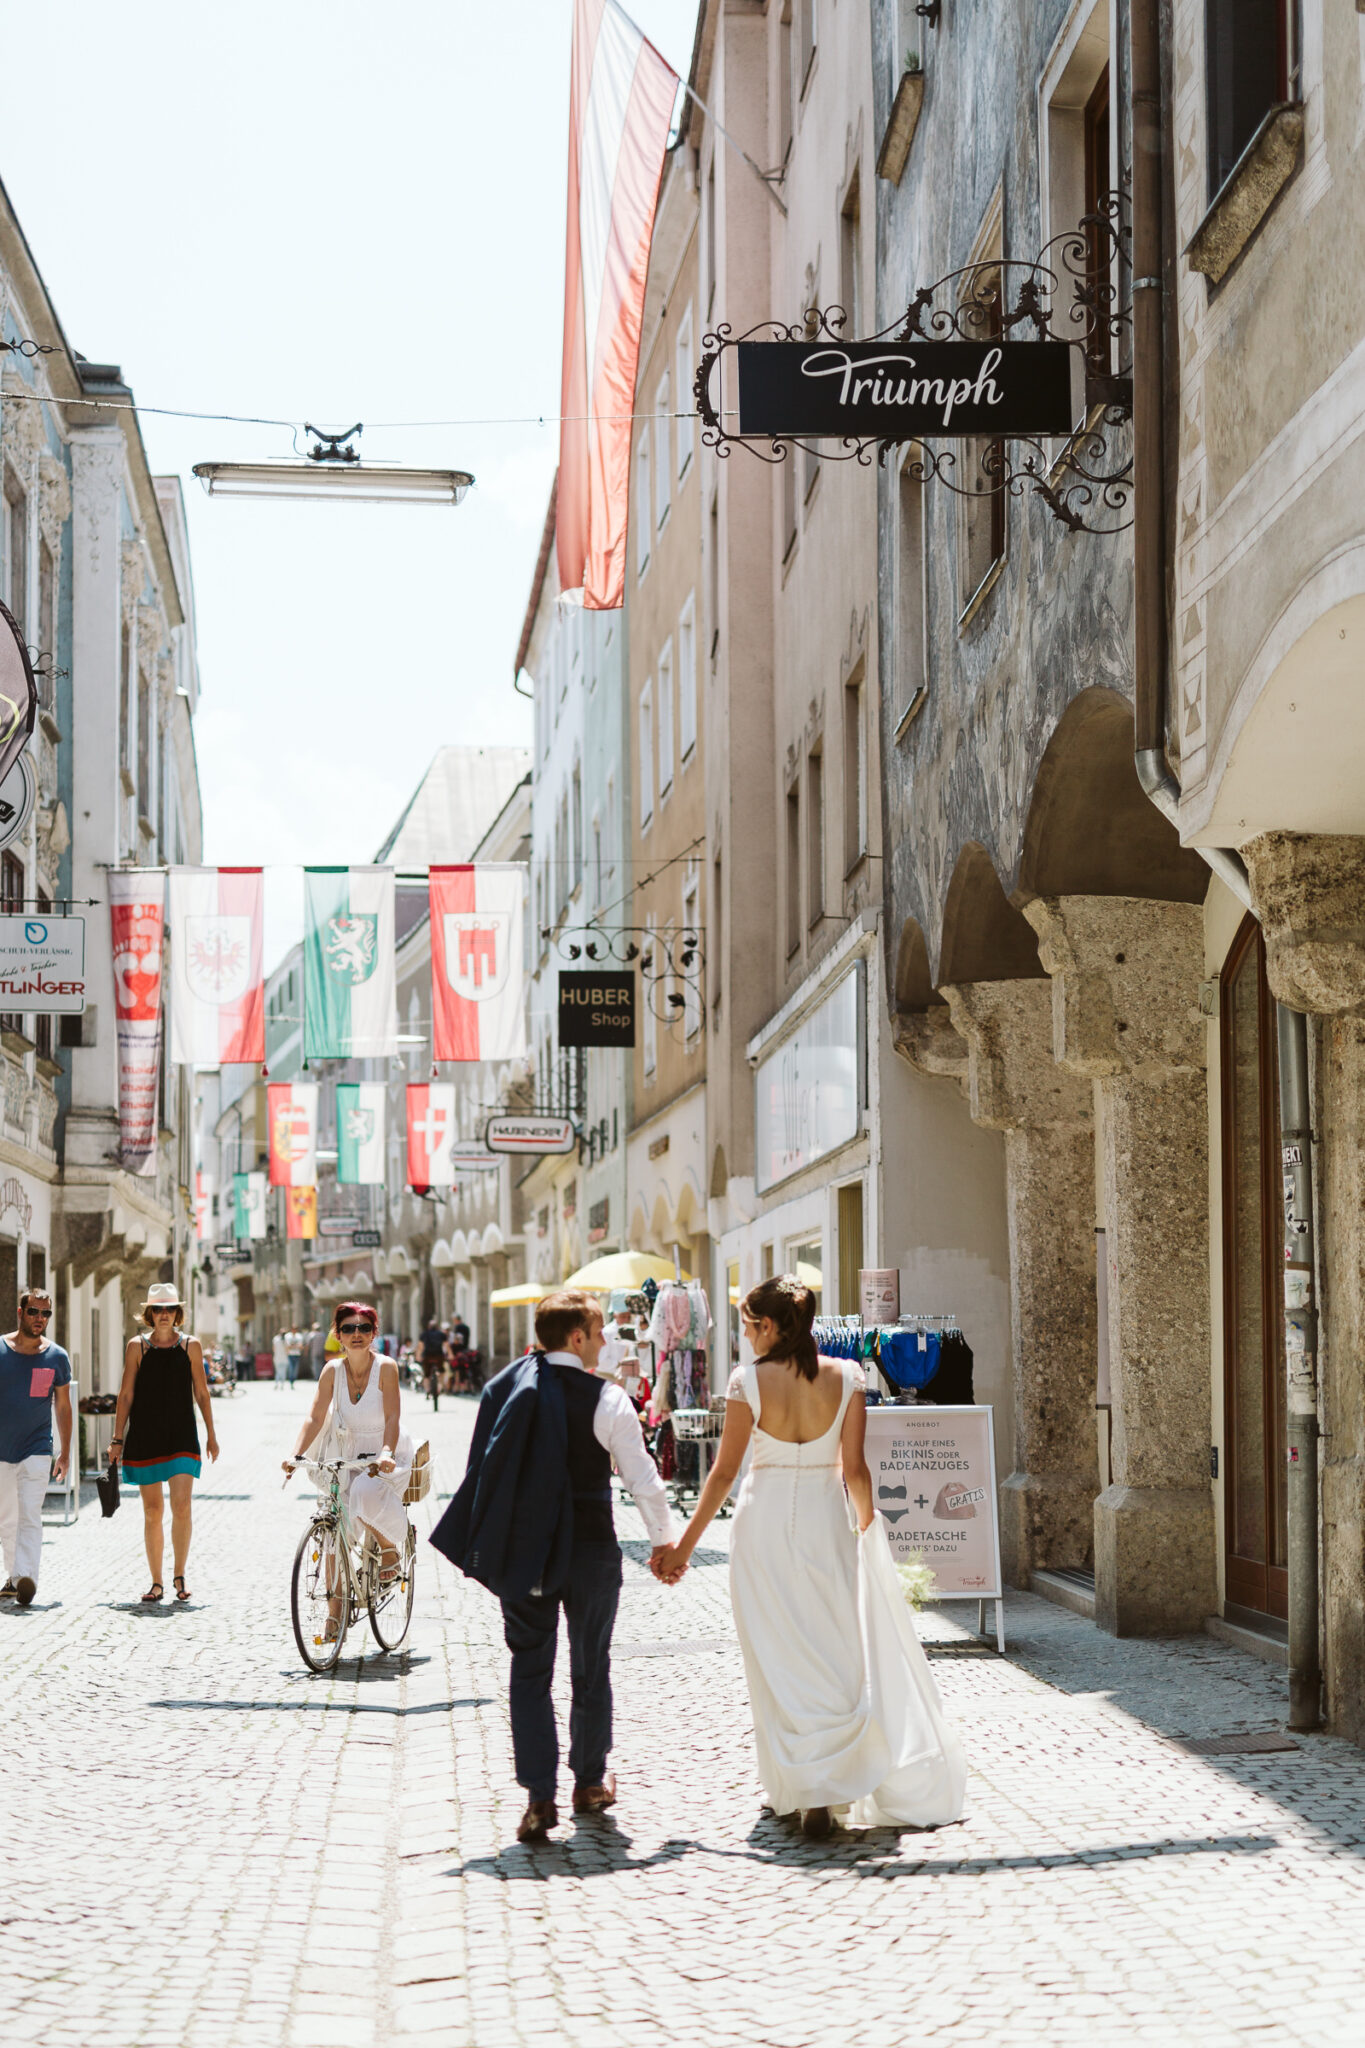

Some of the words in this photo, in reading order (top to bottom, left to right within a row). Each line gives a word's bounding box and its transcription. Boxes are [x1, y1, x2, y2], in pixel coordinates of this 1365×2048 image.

[801, 348, 1003, 427] Triumph
[561, 988, 631, 1005] HUBER
[591, 1012, 631, 1028] Shop
[891, 1449, 935, 1459] BIKINIS
[936, 1451, 960, 1459] ODER
[880, 1461, 970, 1471] BADEANZUGES
[950, 1488, 985, 1508] GRATIS
[888, 1531, 968, 1541] BADETASCHE
[933, 1544, 958, 1552] DAZU
